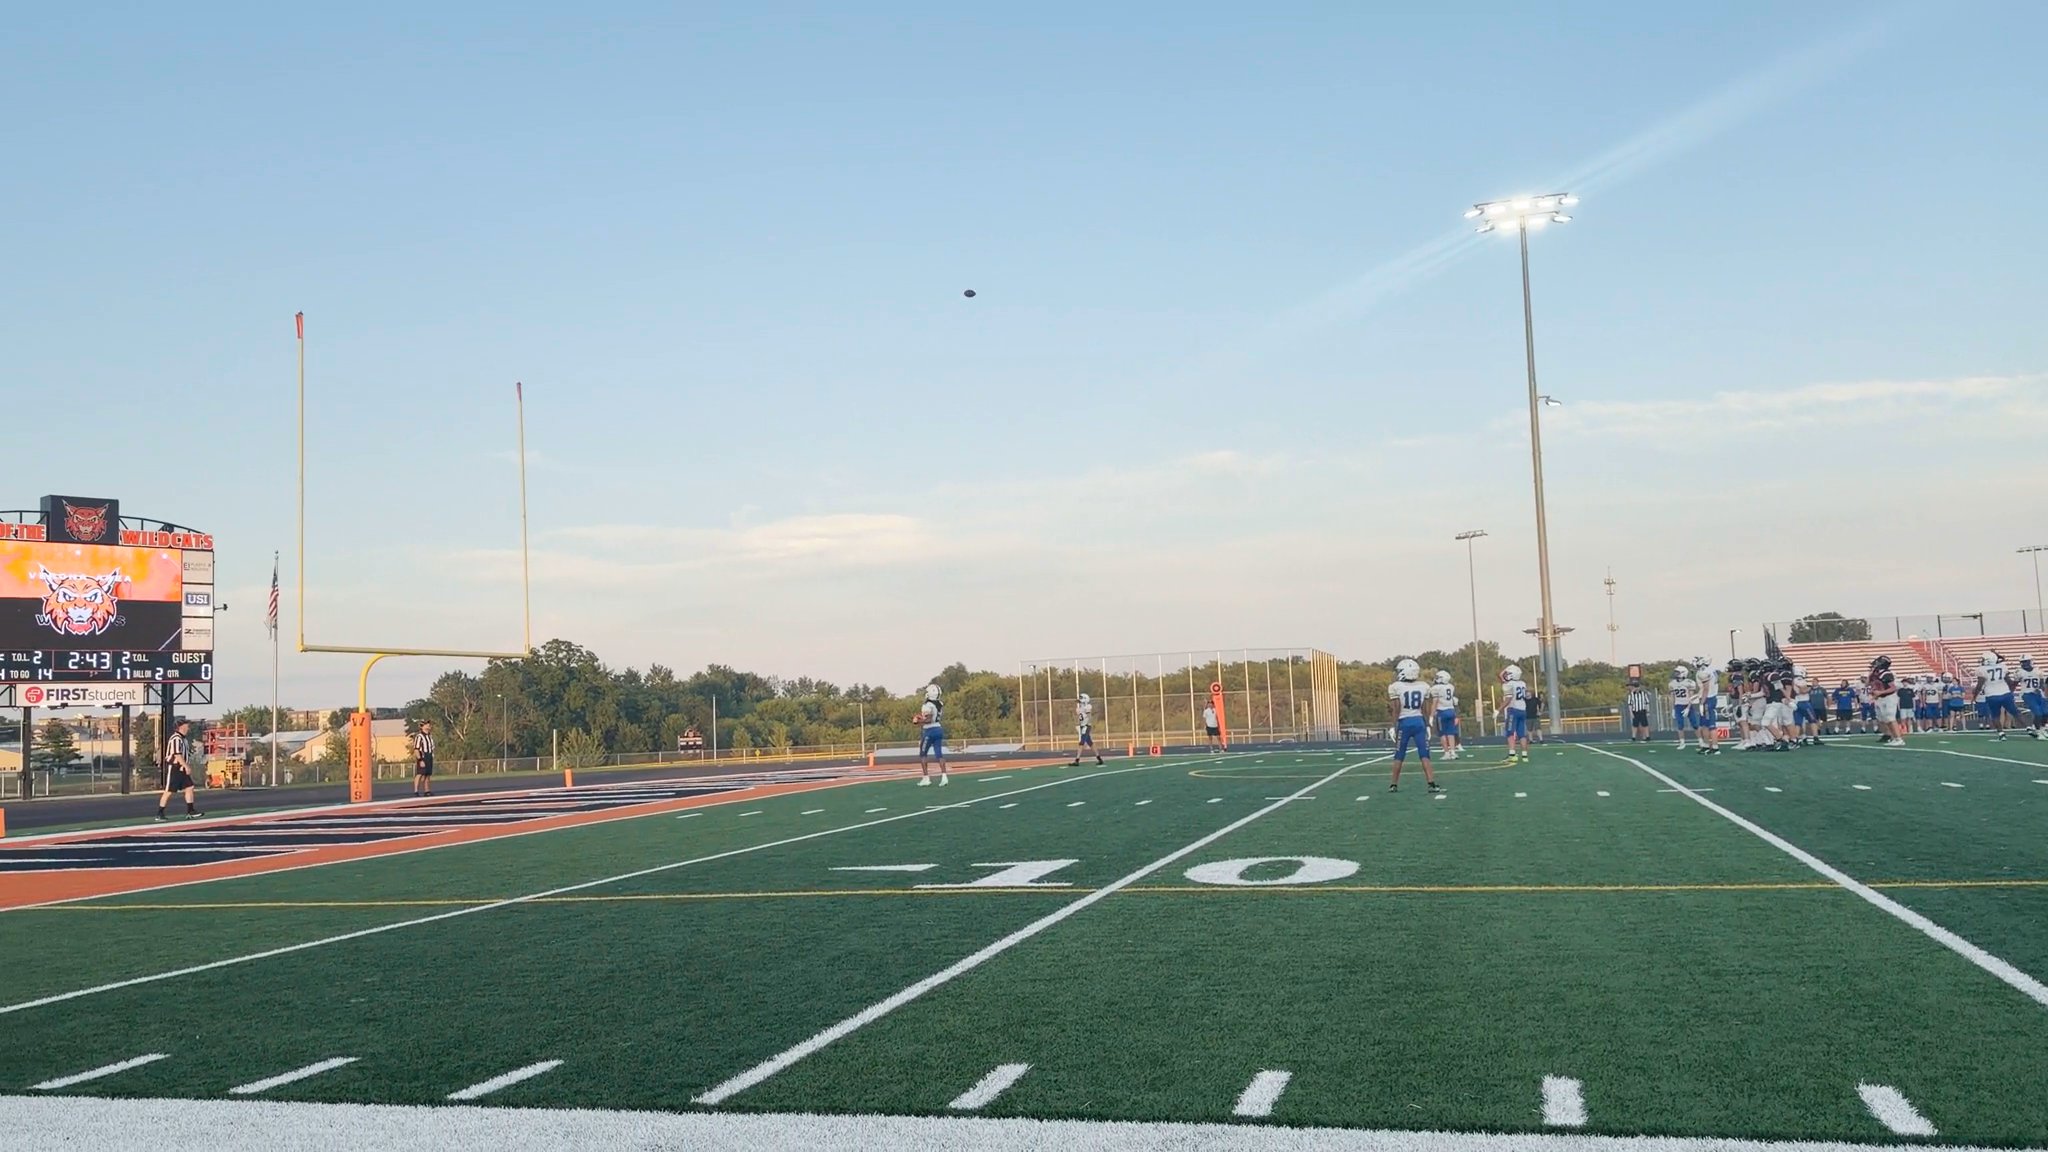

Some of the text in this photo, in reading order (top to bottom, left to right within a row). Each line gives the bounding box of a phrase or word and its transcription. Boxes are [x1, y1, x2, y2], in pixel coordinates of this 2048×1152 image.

[15, 523, 46, 541] THE
[119, 530, 213, 549] WILDCATS
[187, 594, 208, 604] USI
[33, 651, 42, 664] 2
[68, 652, 110, 669] 2:43
[122, 651, 130, 664] 2
[172, 653, 206, 663] GUEST
[10, 670, 19, 679] TO
[20, 670, 30, 679] GO
[38, 668, 52, 680] 14
[117, 667, 130, 680] 17
[154, 667, 163, 680] 2
[167, 669, 179, 678] QTR
[201, 664, 211, 680] 0
[1987, 668, 2003, 681] 77
[2024, 678, 2039, 688] 76
[1403, 690, 1422, 709] 18
[1674, 689, 1687, 697] 22
[1717, 729, 1728, 738] 20
[351, 717, 366, 800] WLDCATS
